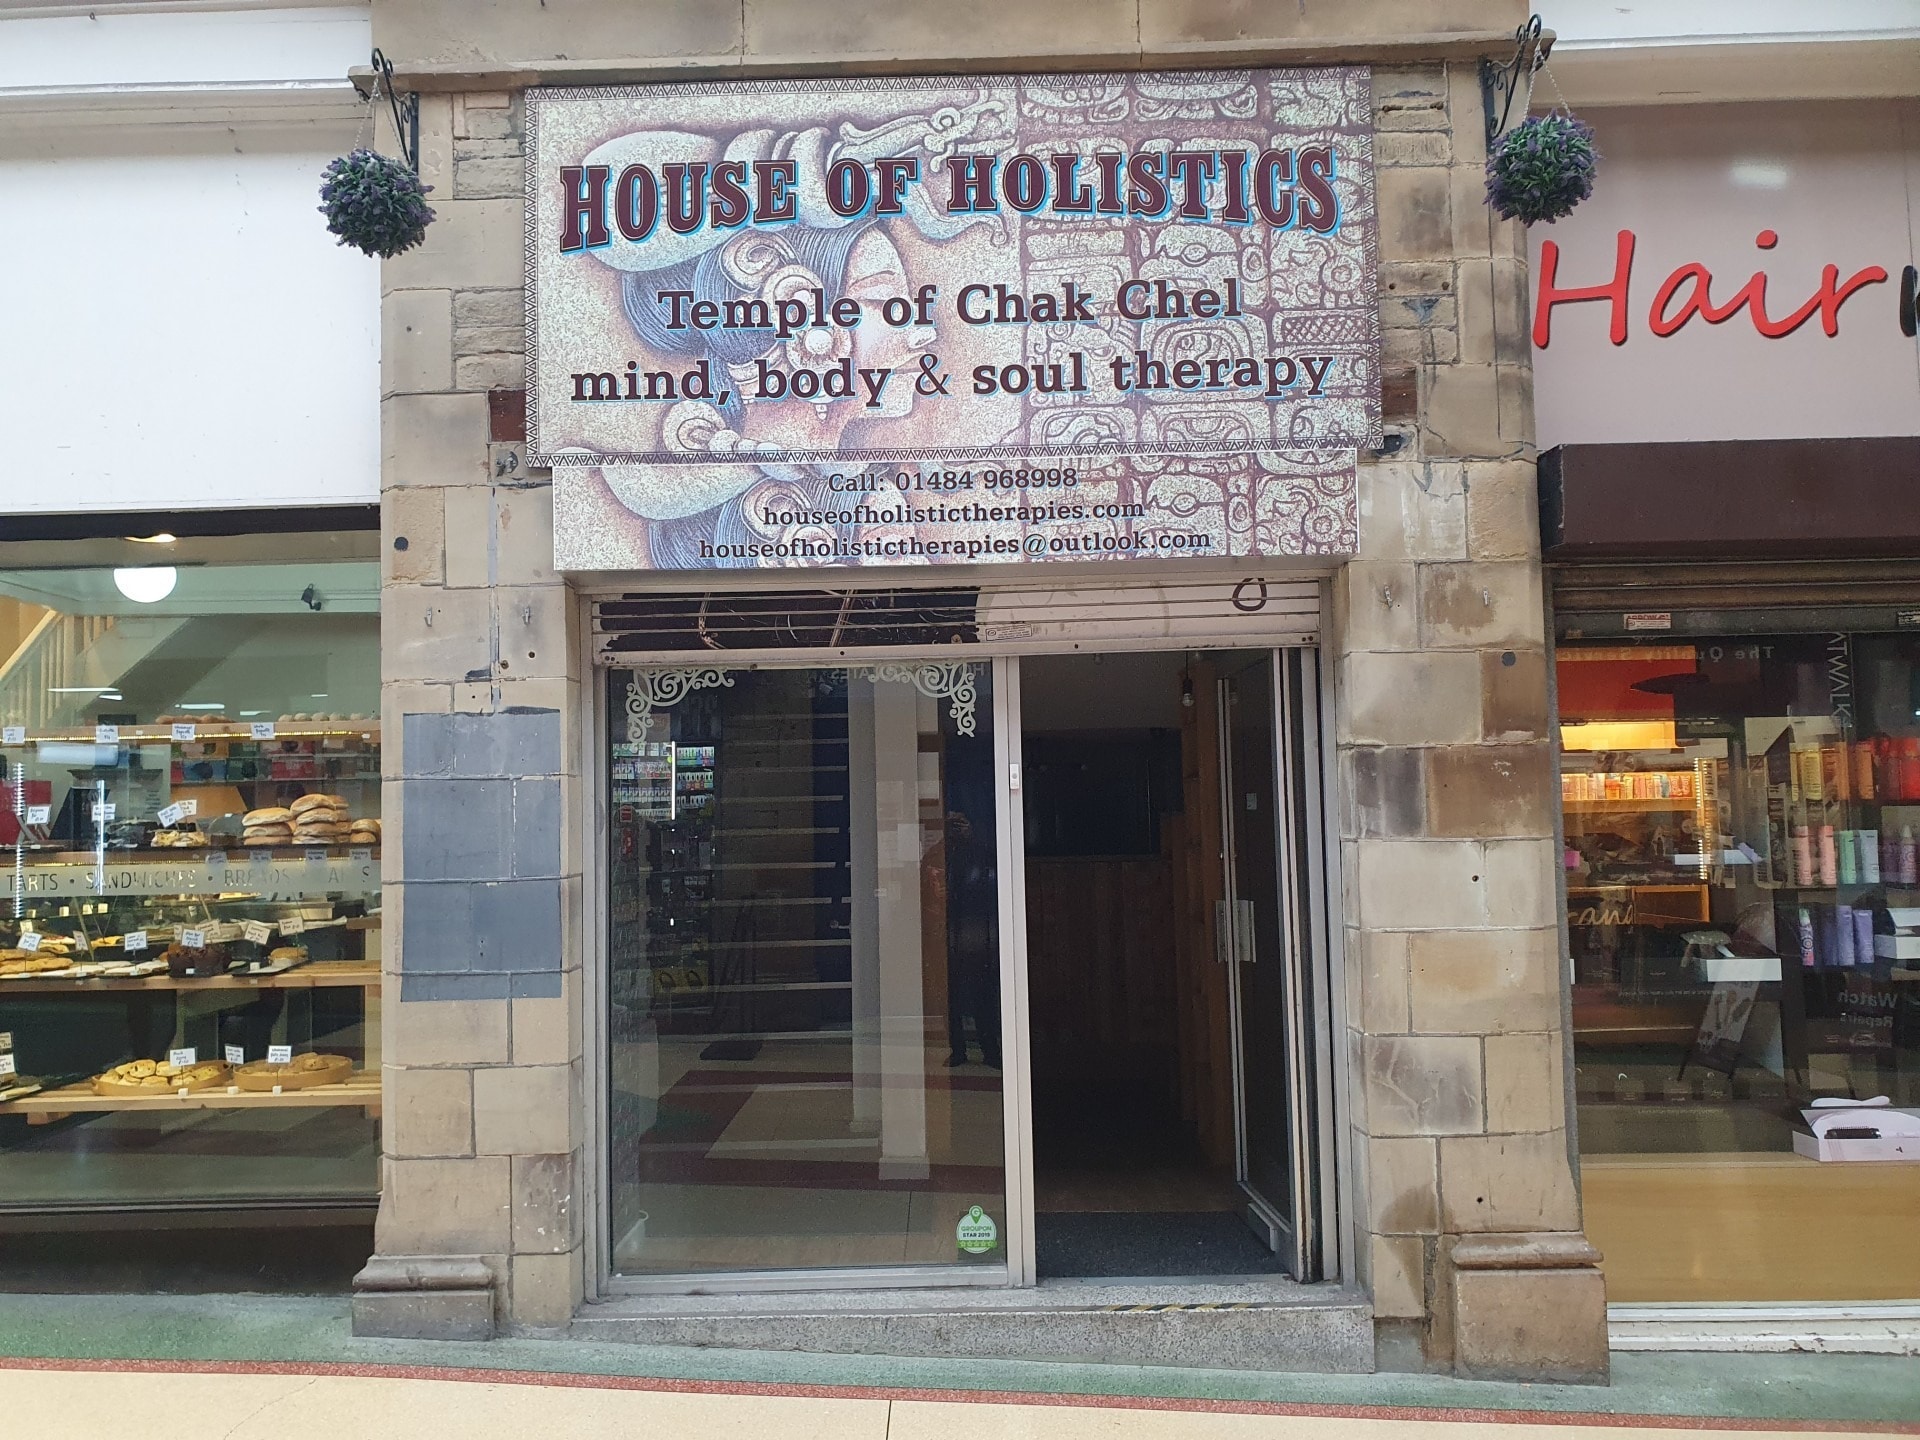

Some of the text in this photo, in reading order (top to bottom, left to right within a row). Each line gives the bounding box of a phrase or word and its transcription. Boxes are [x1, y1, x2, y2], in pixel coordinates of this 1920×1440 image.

[560, 147, 1340, 254] HOUSE OF HOLISTICS
[657, 278, 1243, 340] Temple of Chak Chel
[1532, 229, 1889, 350] Hair
[570, 350, 1334, 408] mind, body & soul therapy
[828, 468, 1078, 493] Call: 01484 968998
[763, 501, 1145, 526] houseofholistictherapies.com
[699, 531, 1212, 558] houseofholistictherapies@outlook.com
